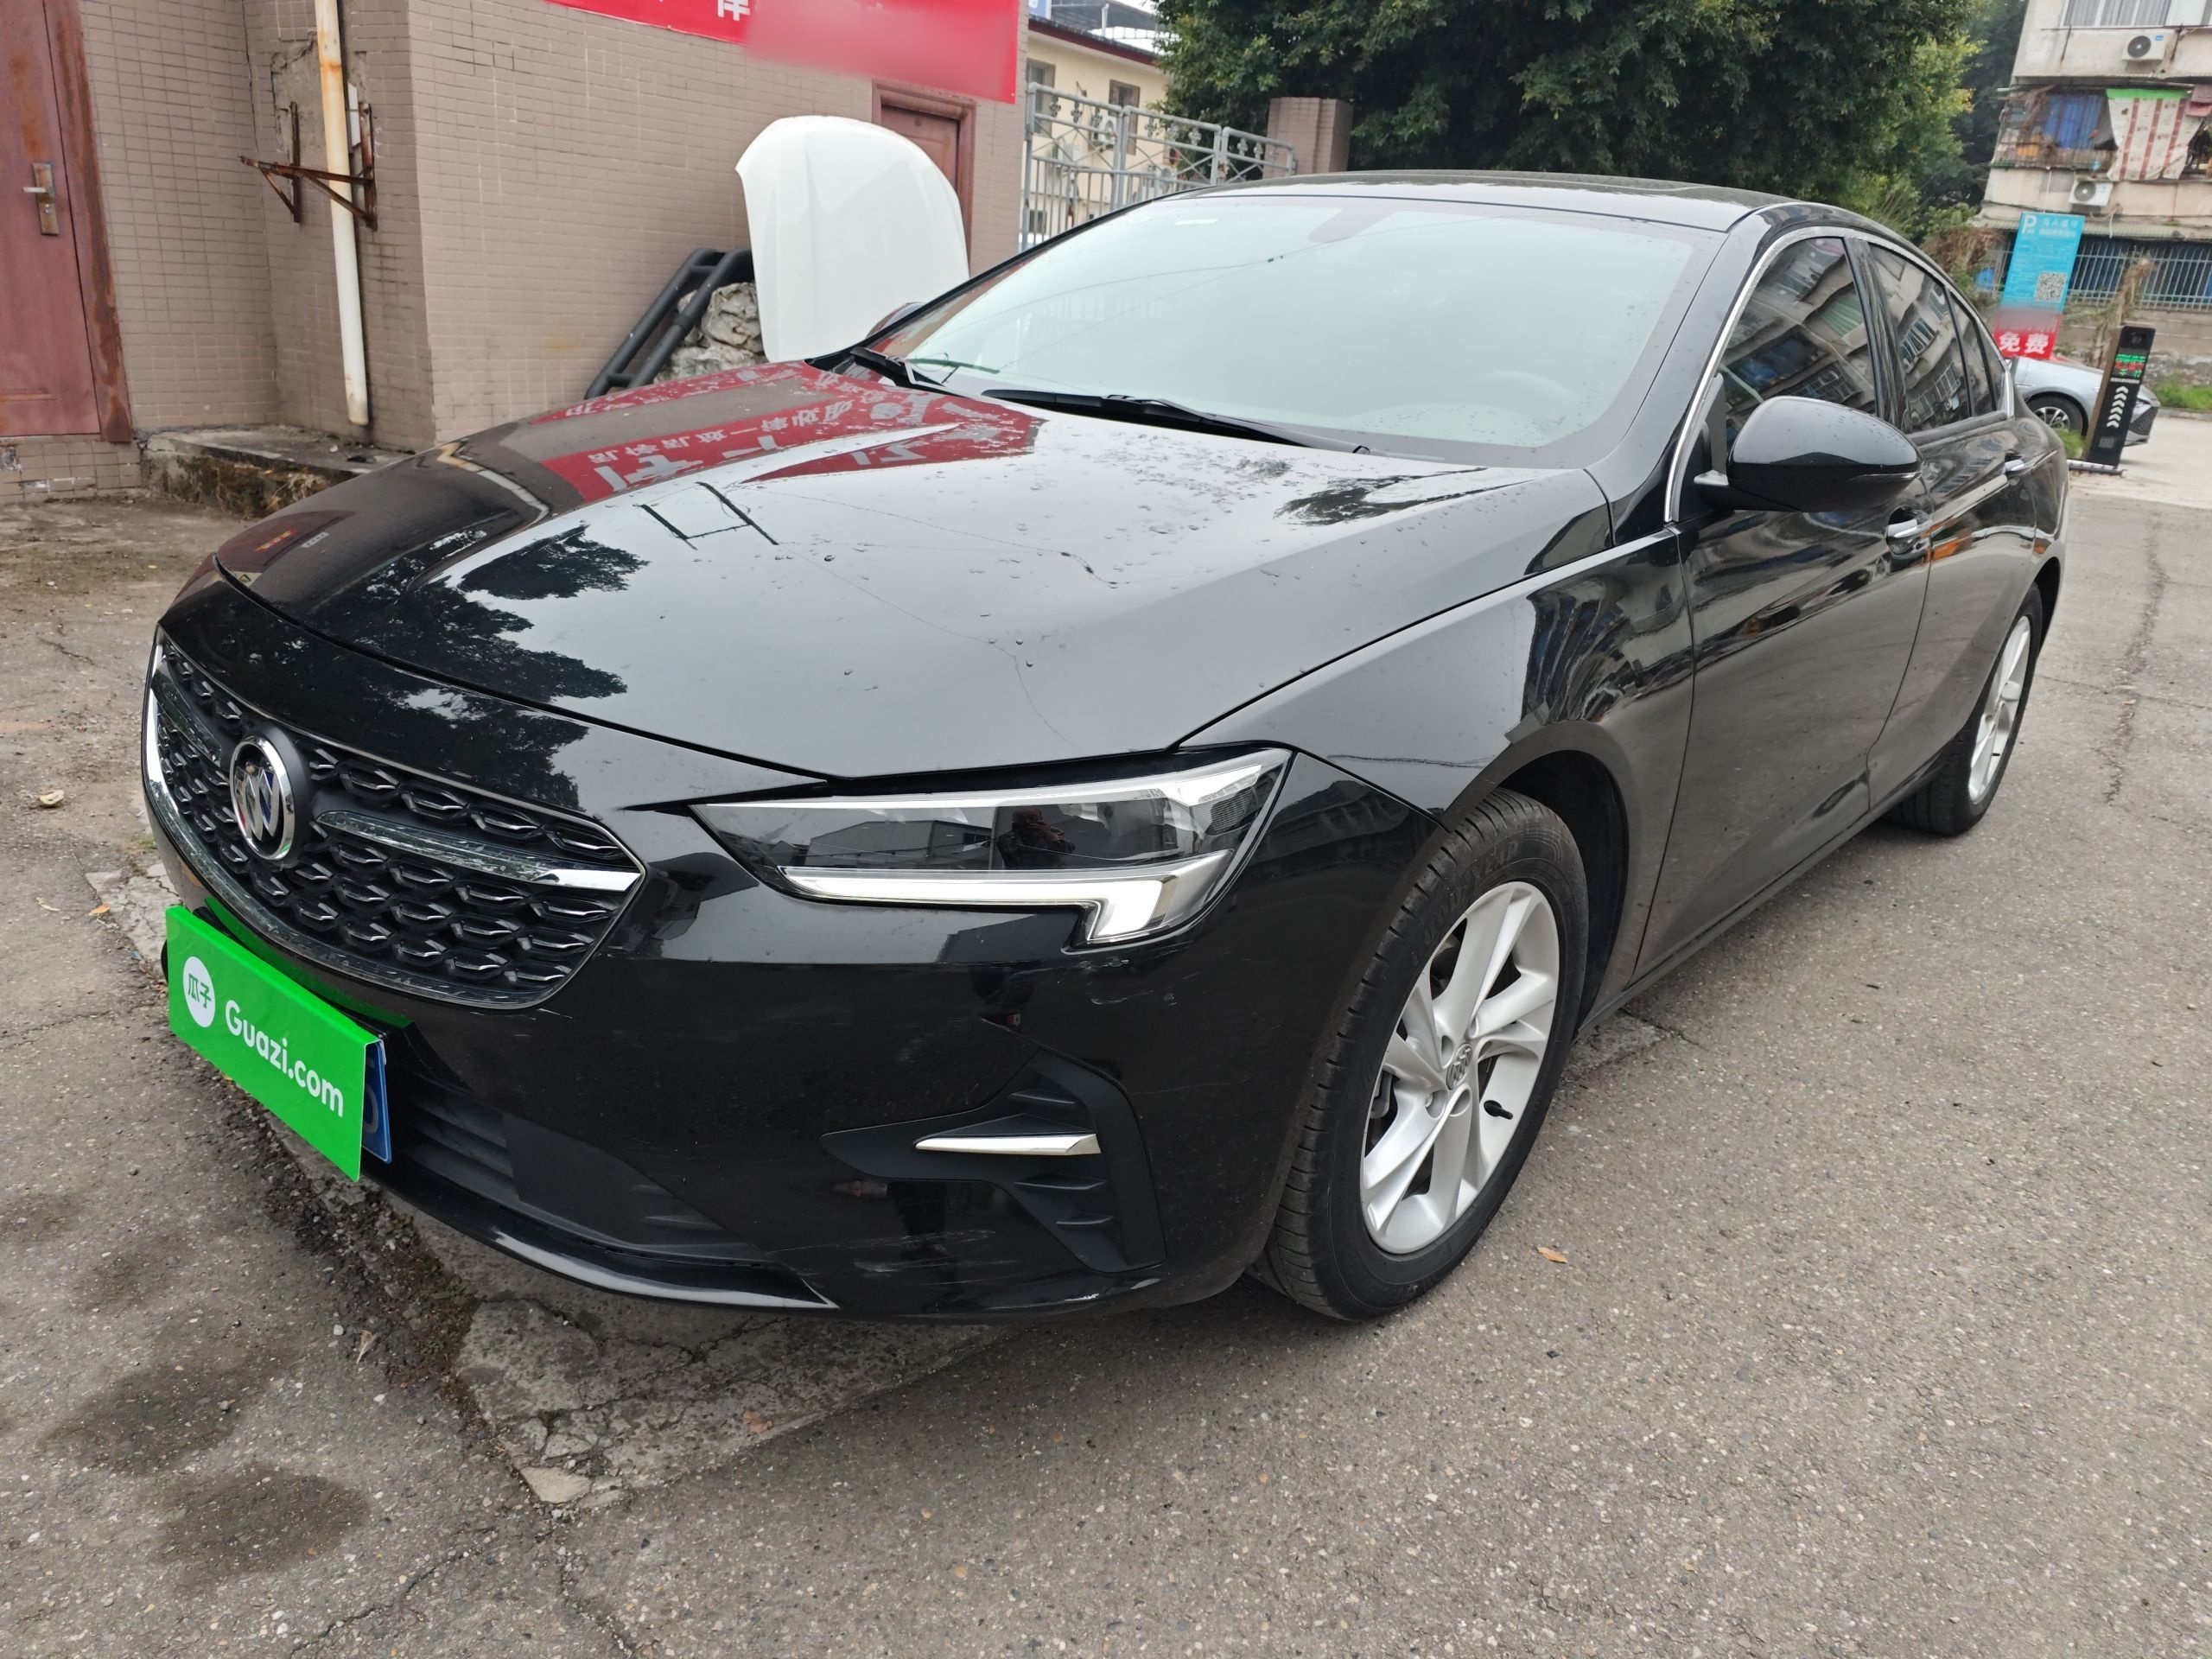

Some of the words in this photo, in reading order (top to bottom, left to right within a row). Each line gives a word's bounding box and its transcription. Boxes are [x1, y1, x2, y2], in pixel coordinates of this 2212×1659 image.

[1999, 331, 2050, 354] 免费
[188, 973, 212, 1009] 瓜子
[225, 1000, 344, 1118] Guazi.com
